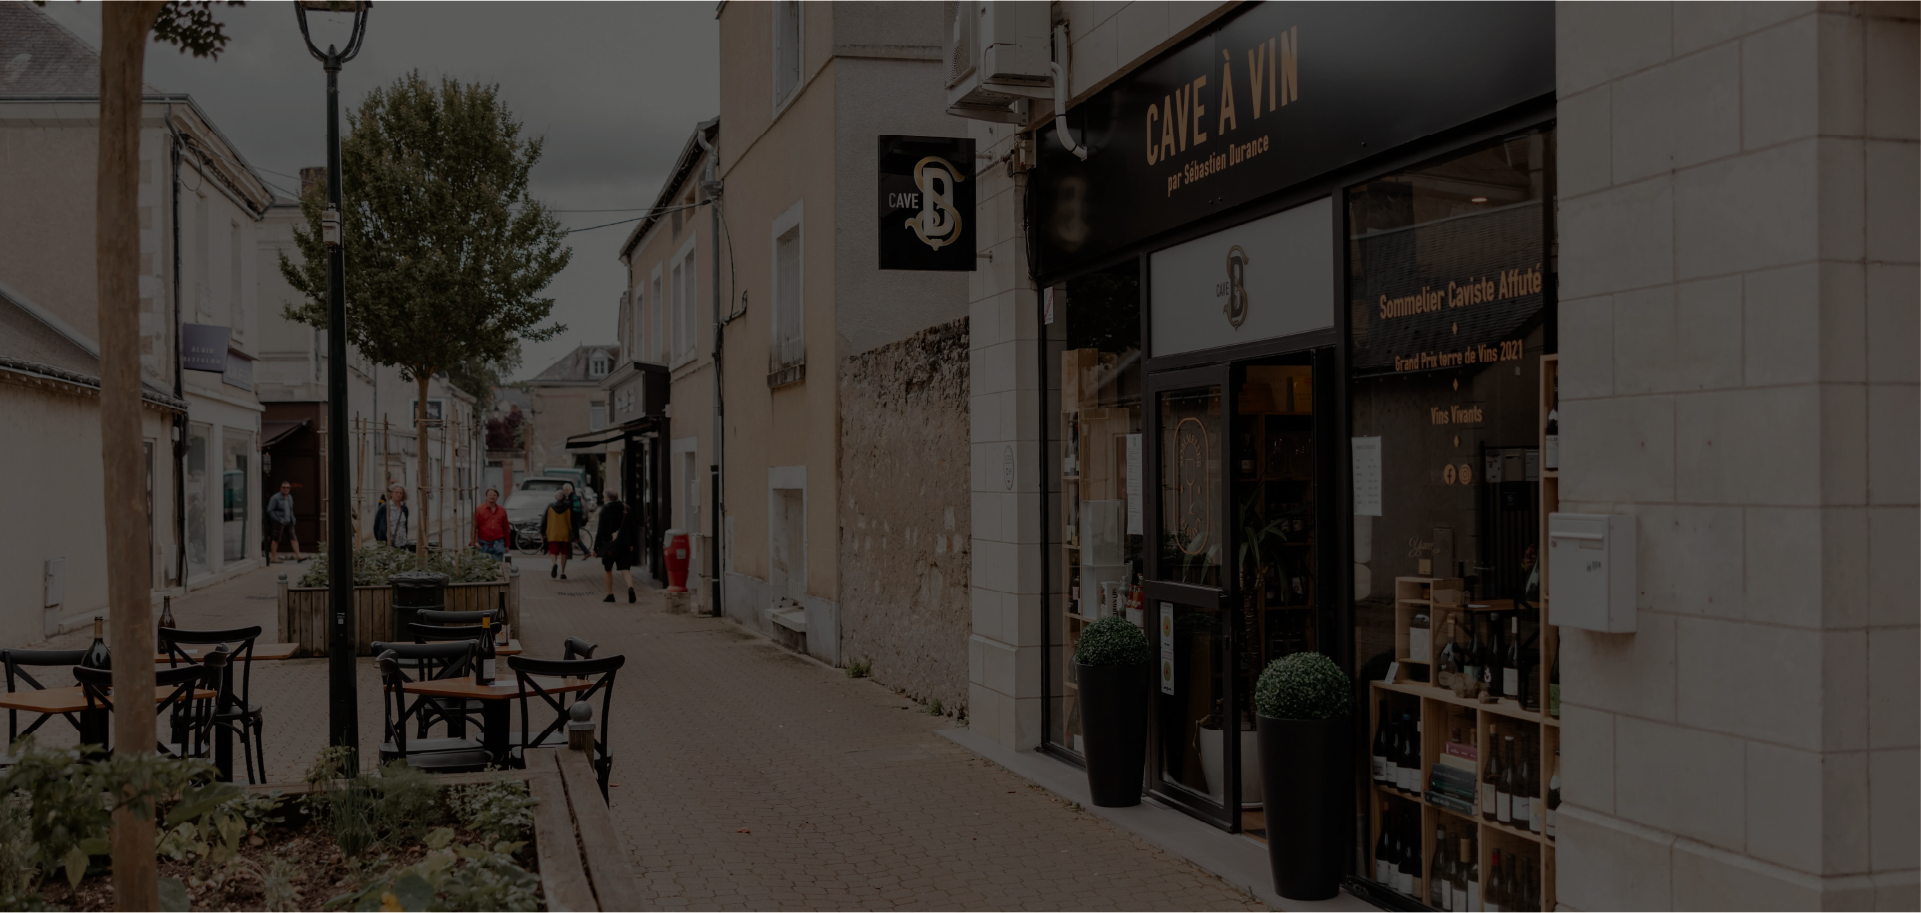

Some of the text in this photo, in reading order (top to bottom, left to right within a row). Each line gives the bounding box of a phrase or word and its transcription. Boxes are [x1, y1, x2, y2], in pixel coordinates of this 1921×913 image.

[1146, 24, 1298, 166] CAVE À VIN
[1167, 134, 1269, 198] par Sébastien Durance
[888, 192, 919, 209] CAVE
[1215, 281, 1229, 298] CAVE
[1379, 262, 1543, 319] Sommelier Caviste Affuté
[1394, 353, 1419, 372] Grand
[1421, 351, 1438, 368] Prix
[1464, 346, 1476, 364] de
[1477, 343, 1498, 362] Vins
[1500, 338, 1523, 361] 2021
[1430, 405, 1483, 425] Vins Vivants
